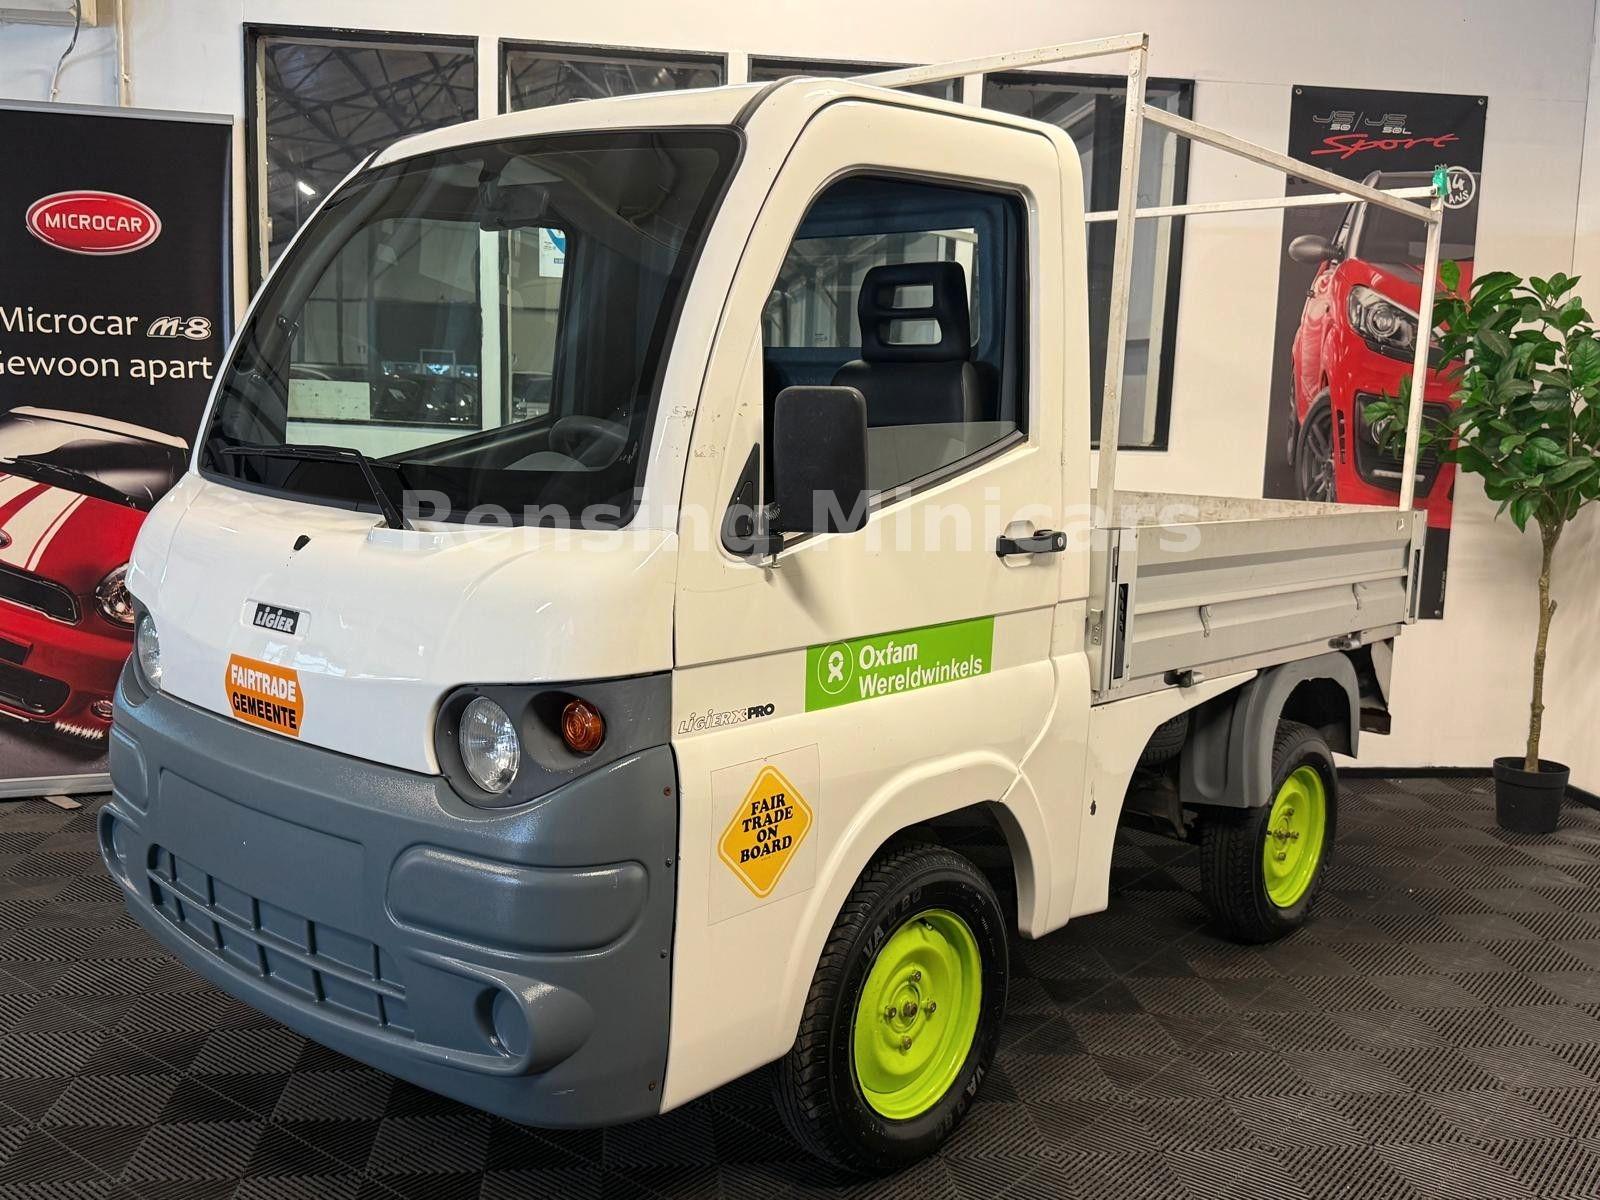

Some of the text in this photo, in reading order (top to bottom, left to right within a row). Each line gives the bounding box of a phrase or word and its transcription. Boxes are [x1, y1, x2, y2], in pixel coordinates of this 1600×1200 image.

[1310, 133, 1459, 160] Sport
[1448, 190, 1470, 205] ANS
[44, 212, 142, 232] MICROCAR
[0, 307, 139, 336] Microcar
[0, 352, 214, 385] ewoon apart
[858, 640, 919, 670] Oxfam
[231, 663, 297, 703] FAIRTRADE
[858, 654, 983, 699] Wereldwinkels
[232, 691, 298, 730] GEMEENTE
[742, 805, 793, 832] TRADE
[751, 793, 786, 816] FAIR
[756, 824, 778, 843] ON
[740, 835, 793, 863] BOARD
